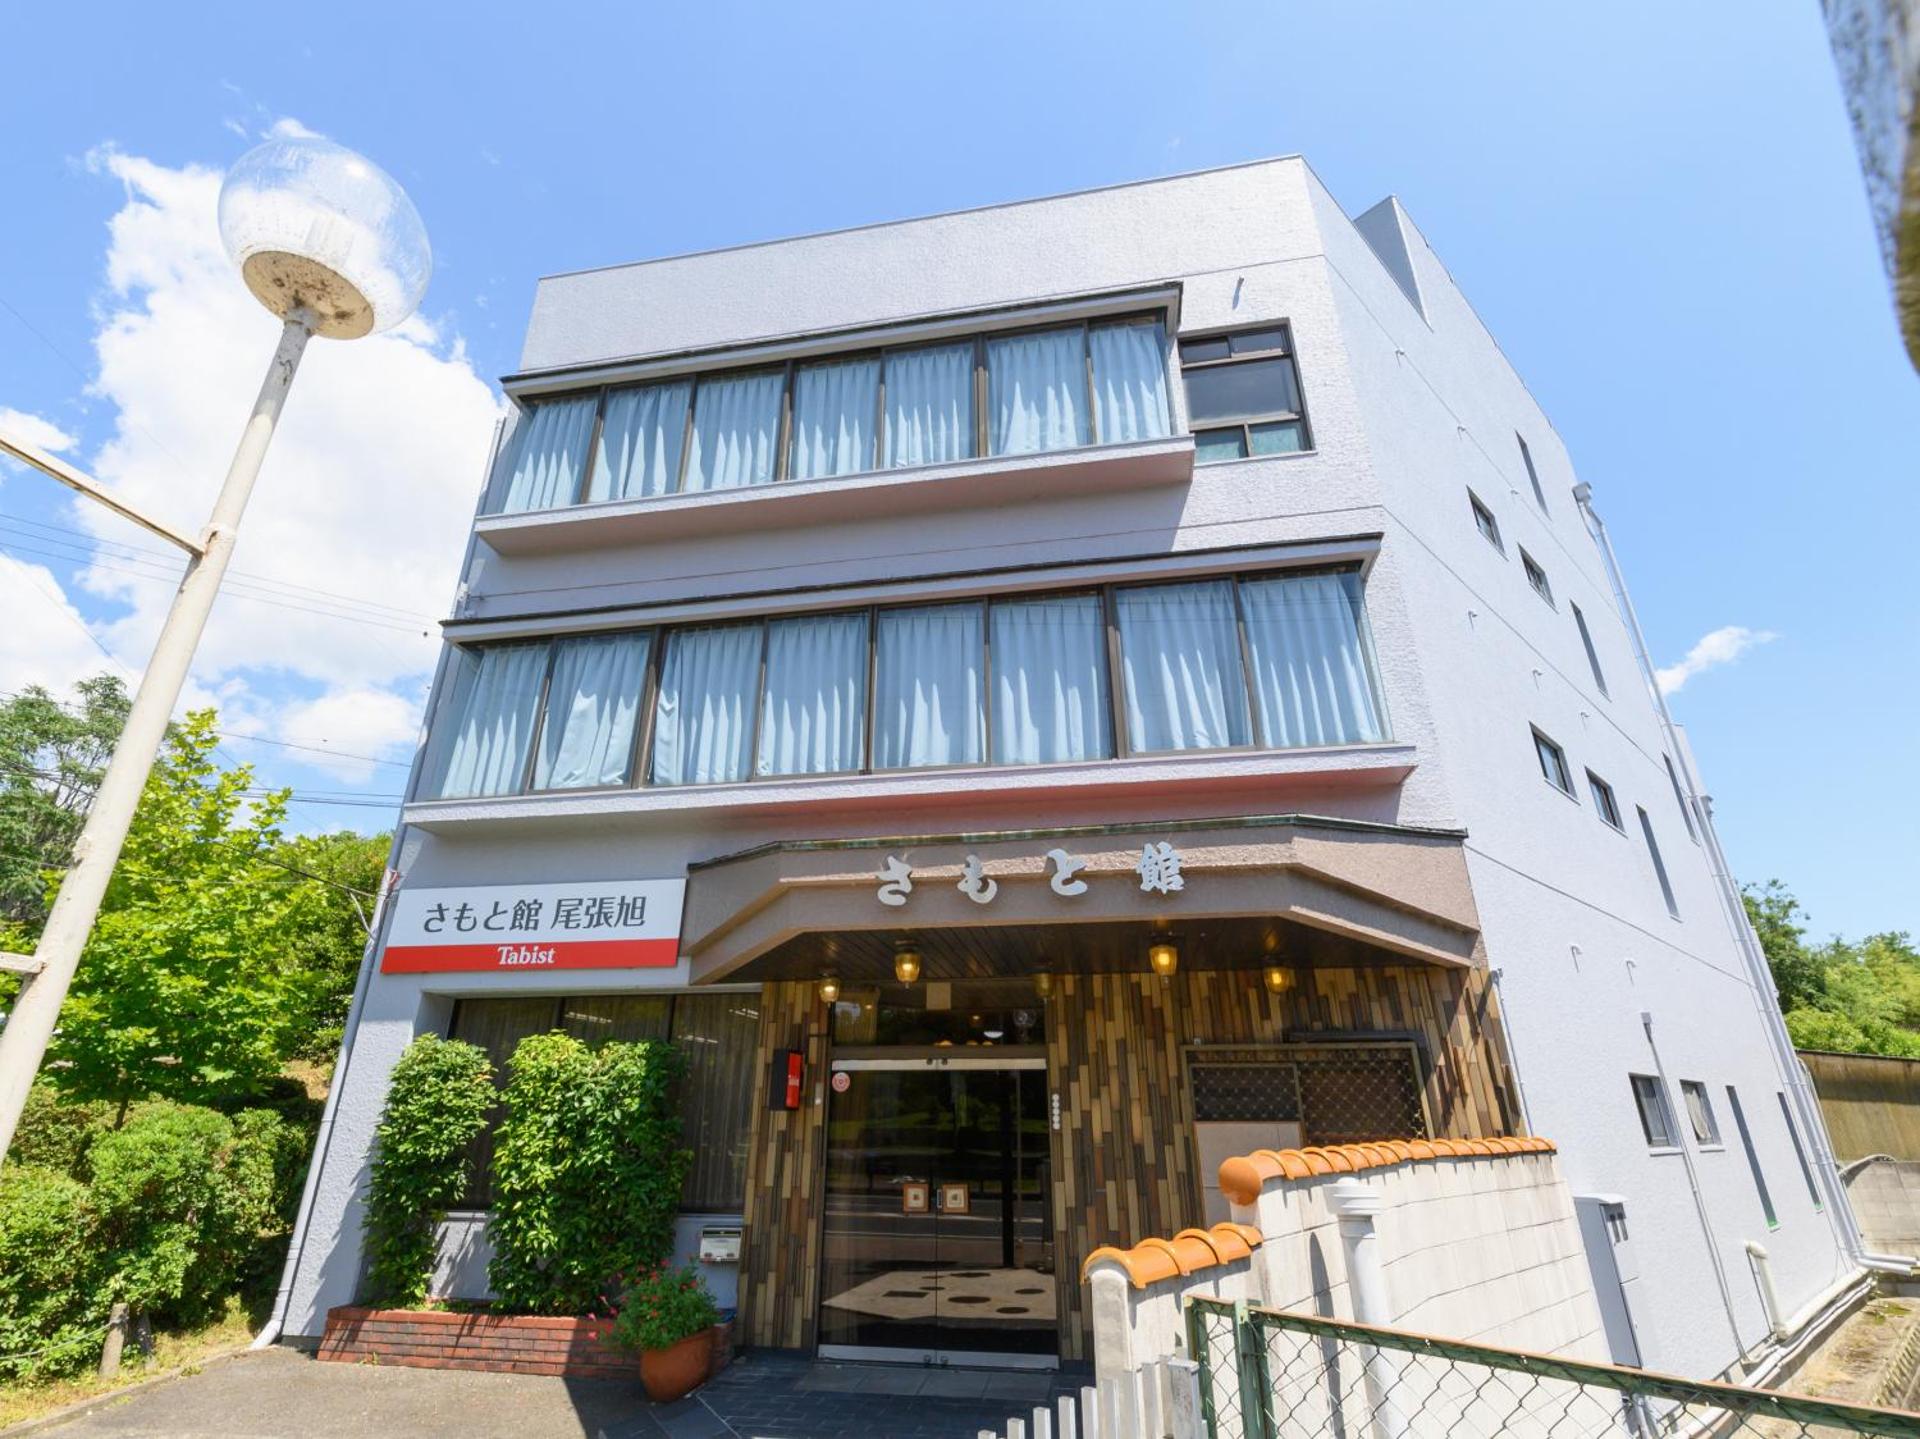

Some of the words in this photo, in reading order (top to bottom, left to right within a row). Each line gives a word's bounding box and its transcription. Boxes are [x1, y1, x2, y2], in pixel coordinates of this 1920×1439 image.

[876, 841, 1185, 906] さもと館
[423, 899, 543, 933] さもと館
[550, 896, 647, 930] 尾張旭
[498, 945, 556, 965] Tabist
